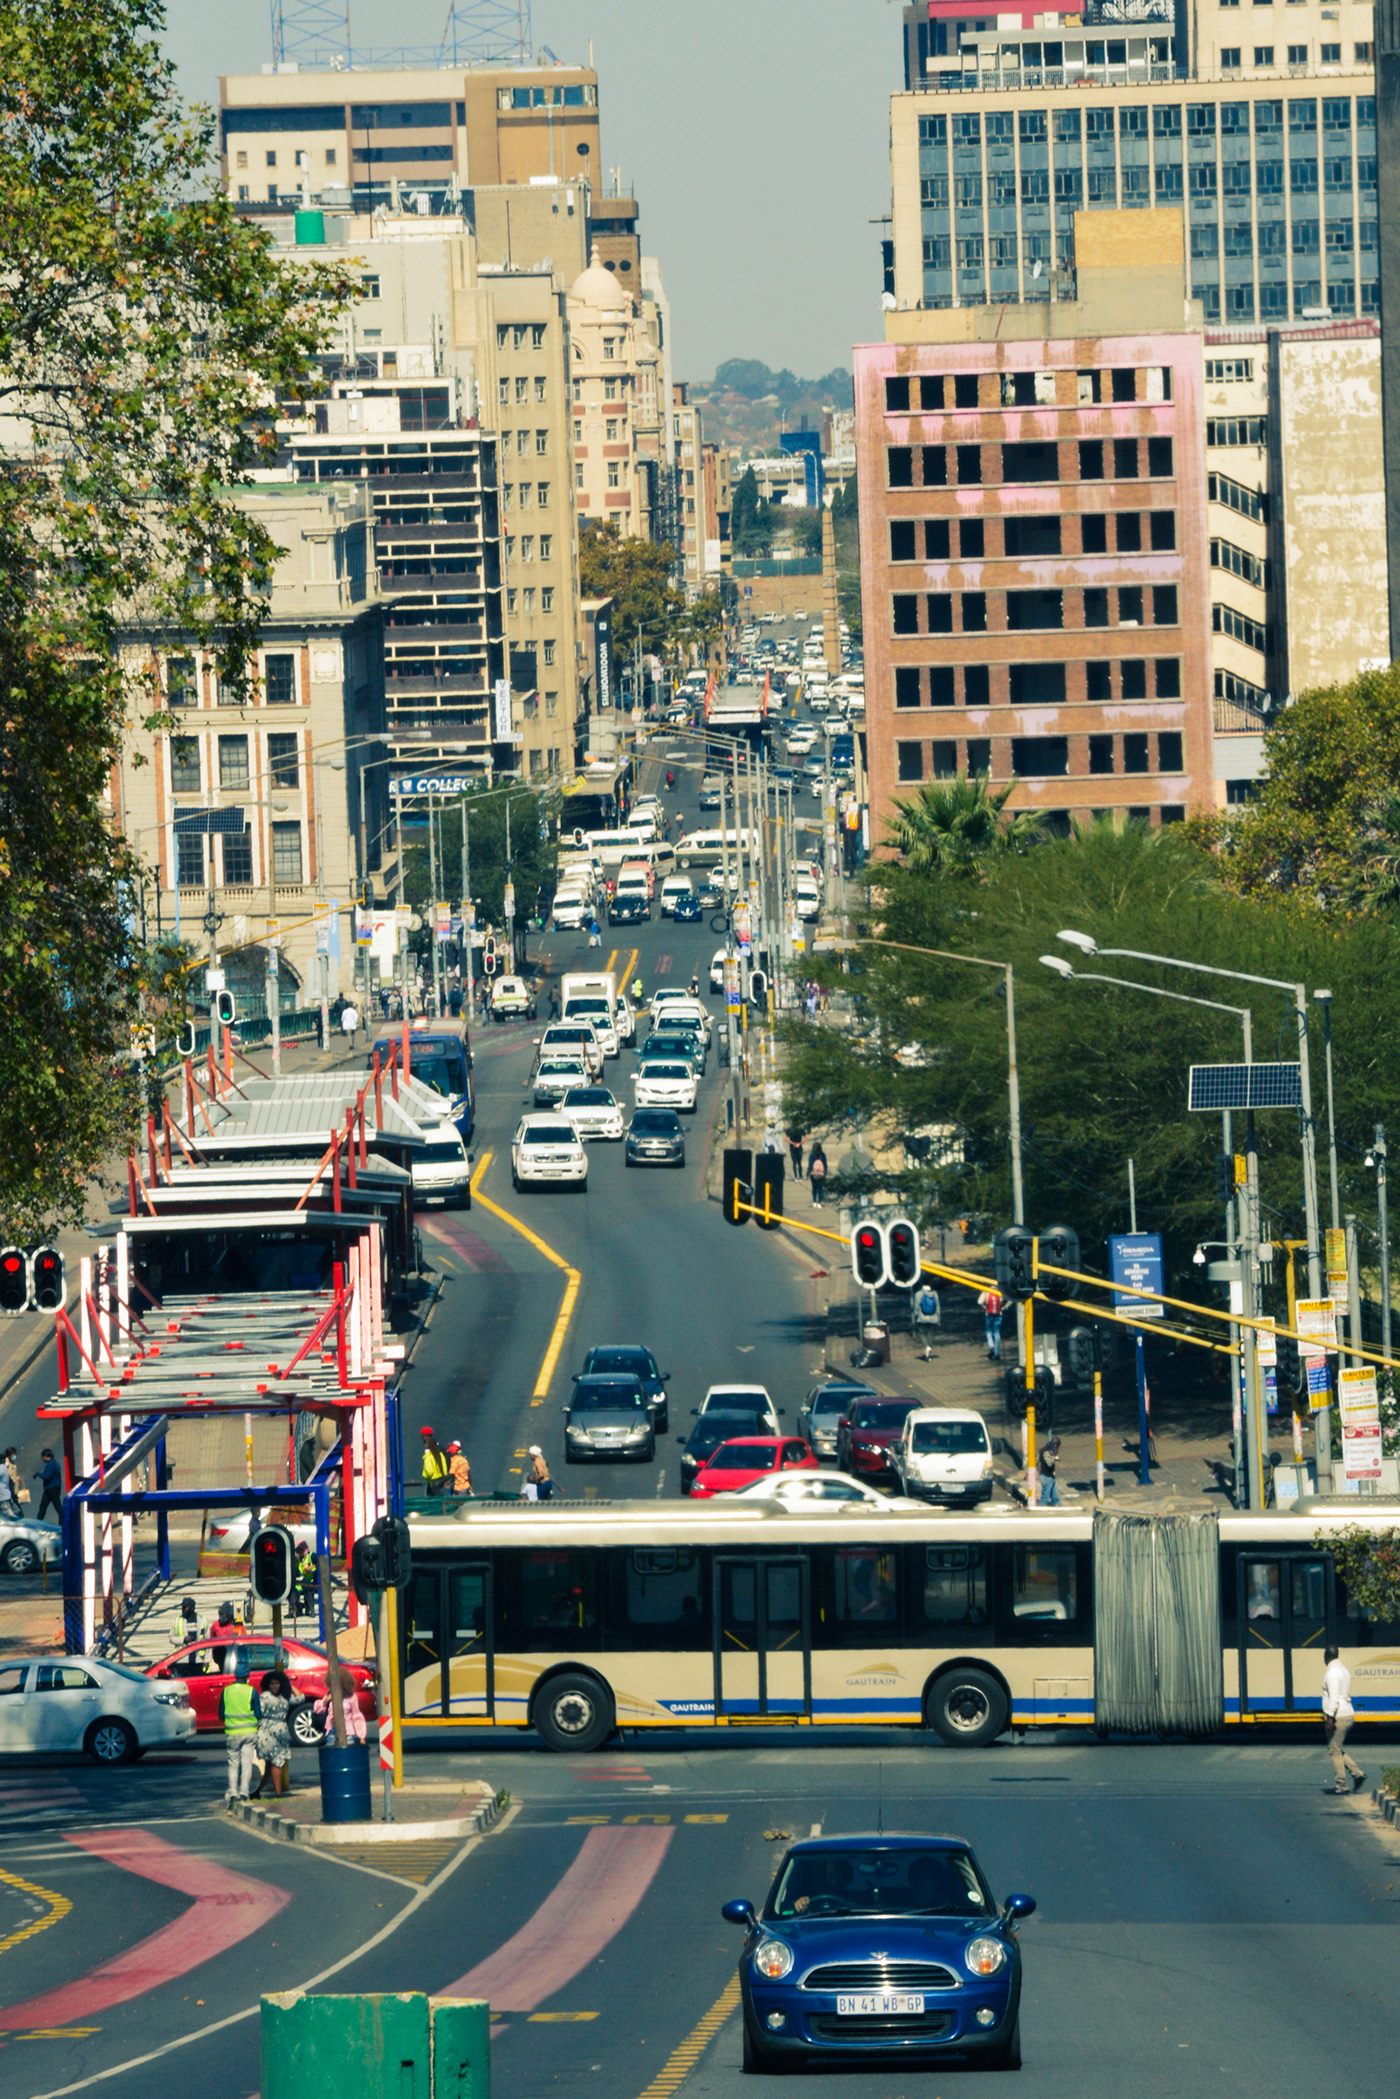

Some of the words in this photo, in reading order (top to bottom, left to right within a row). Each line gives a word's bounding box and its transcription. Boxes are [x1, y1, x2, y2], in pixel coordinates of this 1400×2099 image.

[600, 642, 610, 707] WOOLWORTHS
[499, 681, 508, 732] VECTOR
[846, 1678, 896, 1686] GAUTRAIN
[670, 1703, 715, 1712] GAUTRAIN
[839, 1998, 855, 2012] BN
[861, 1998, 877, 2012] 41
[882, 1997, 898, 2011] WB
[907, 1996, 922, 2011] GP
